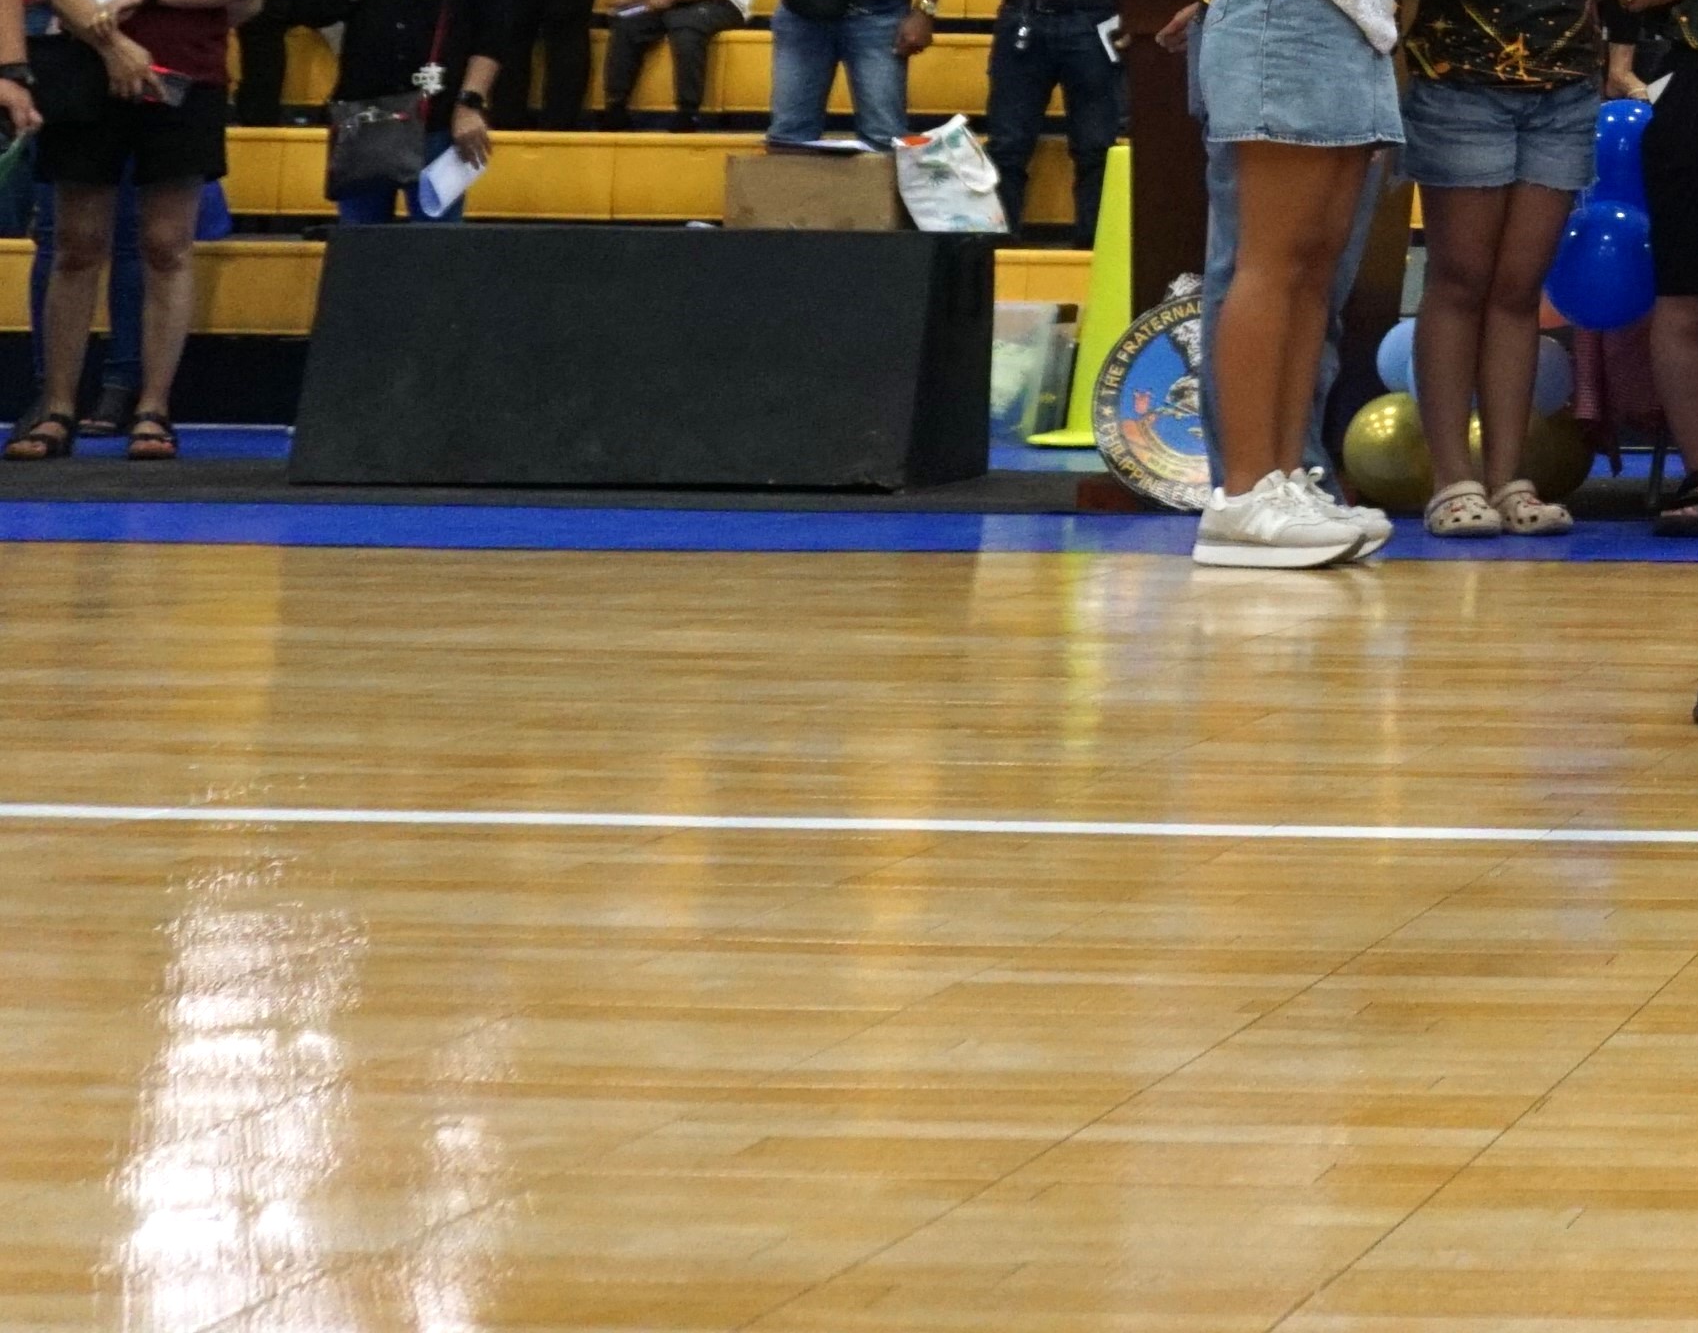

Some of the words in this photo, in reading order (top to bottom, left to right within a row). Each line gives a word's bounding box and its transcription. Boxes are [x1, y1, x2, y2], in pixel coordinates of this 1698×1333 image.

[1102, 362, 1125, 395] THE
[1116, 300, 1202, 364] FRATERNAL
[1102, 421, 1165, 498] PHILIPPINE
